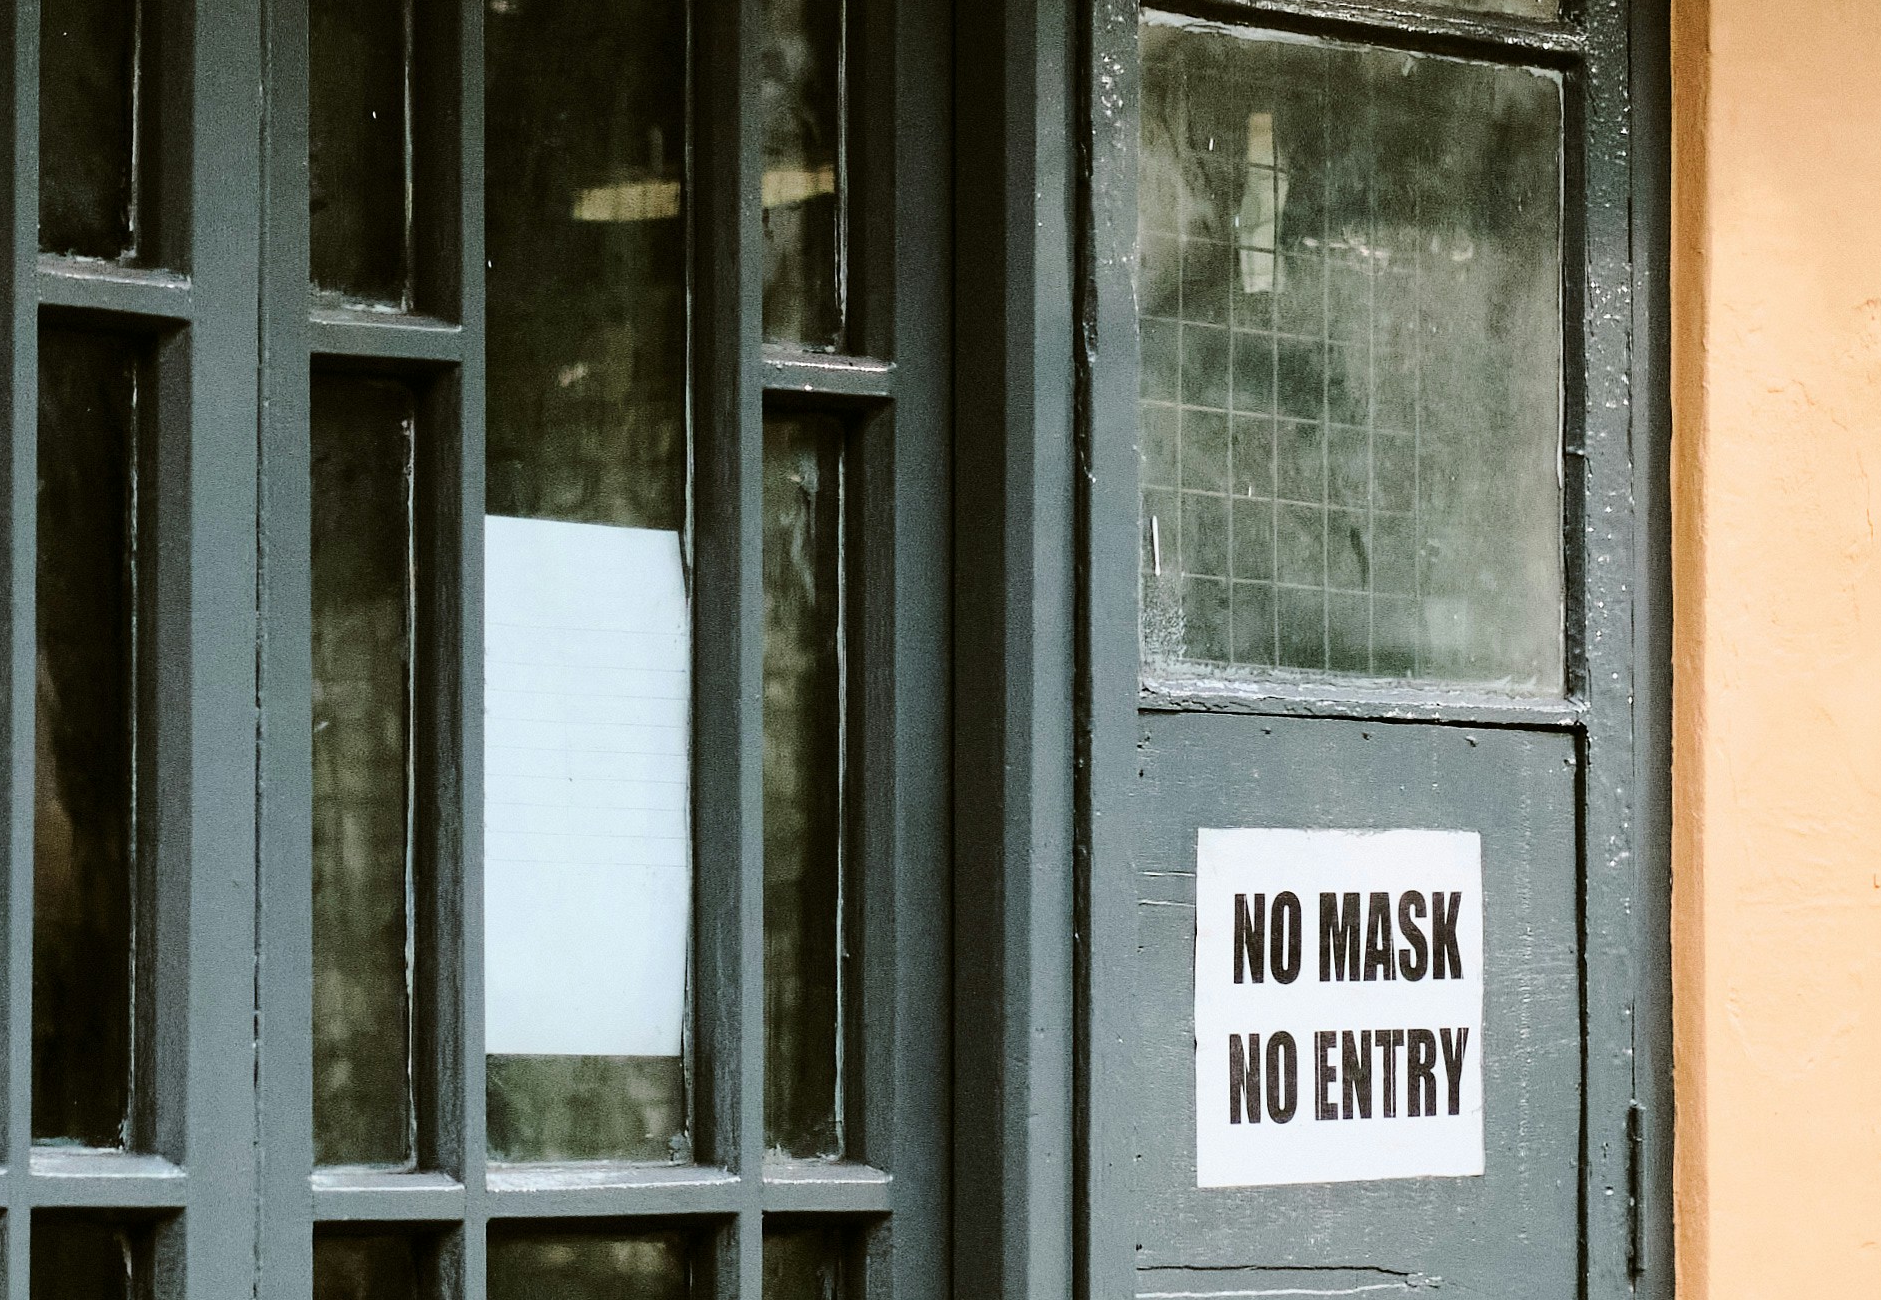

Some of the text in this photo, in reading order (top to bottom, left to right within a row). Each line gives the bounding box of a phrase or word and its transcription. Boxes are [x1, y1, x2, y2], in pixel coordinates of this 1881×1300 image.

[1233, 889, 1464, 985] NO MASK
[1229, 1027, 1470, 1125] NO ENTRY
